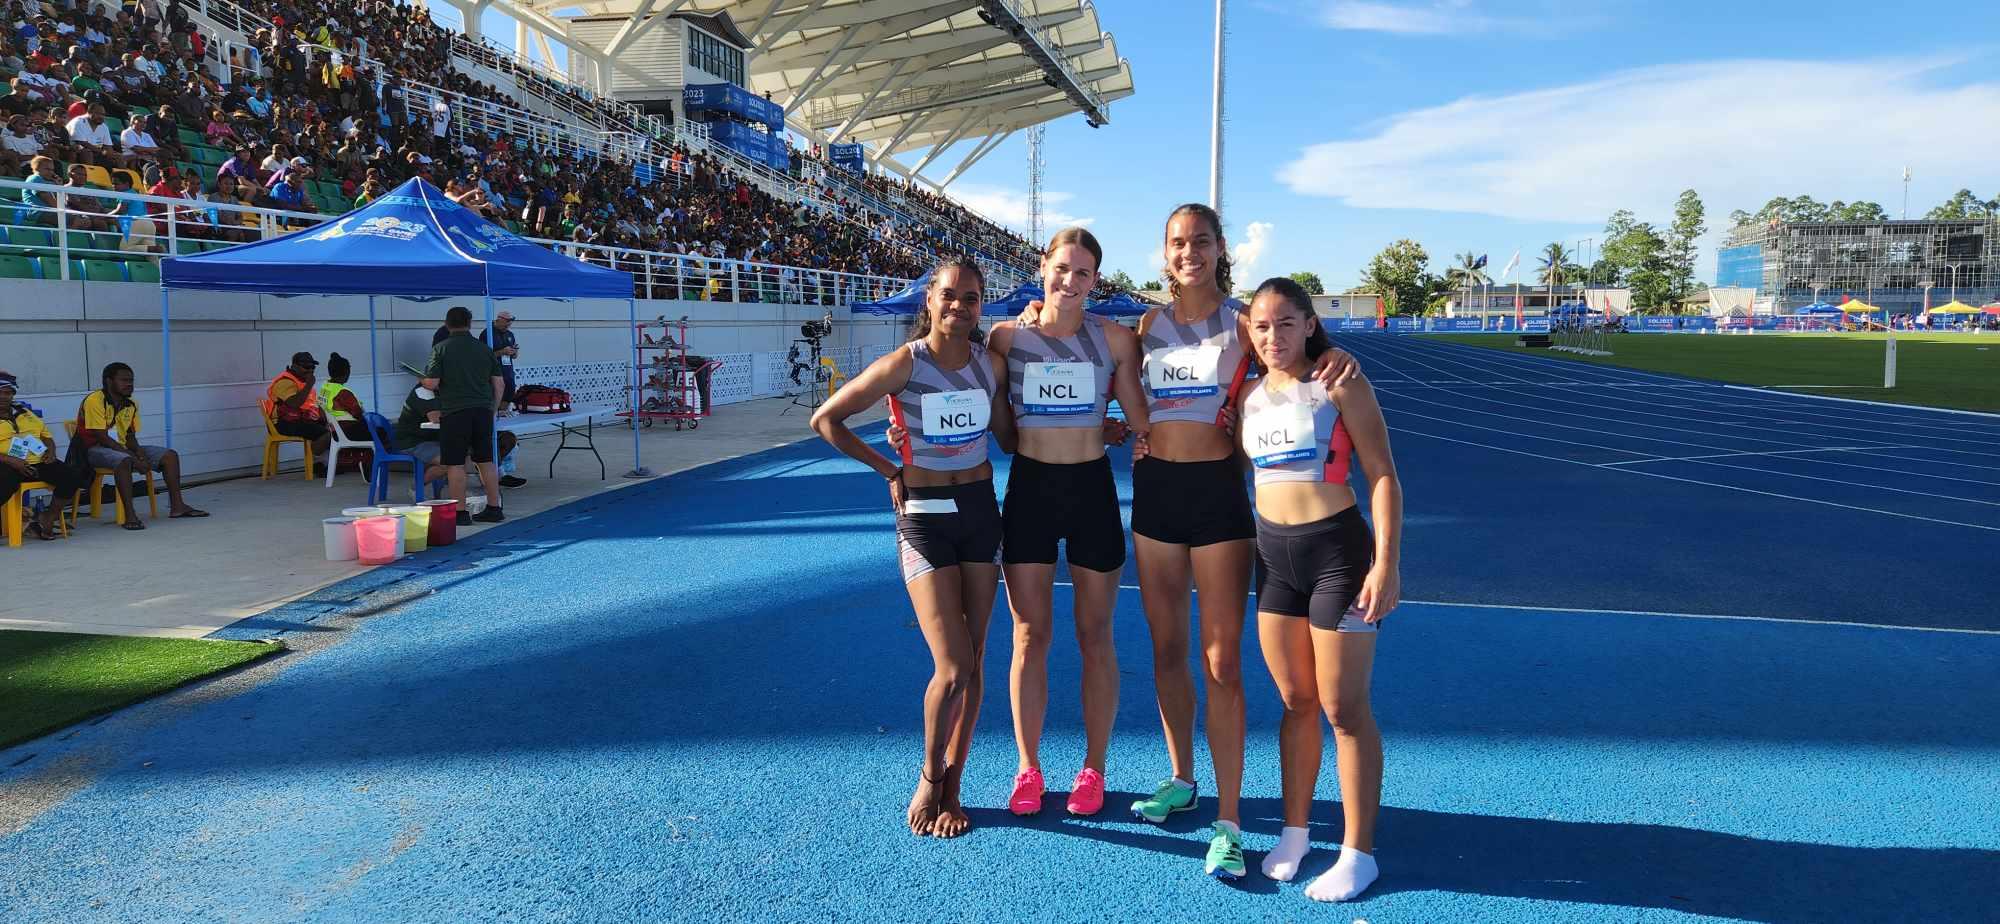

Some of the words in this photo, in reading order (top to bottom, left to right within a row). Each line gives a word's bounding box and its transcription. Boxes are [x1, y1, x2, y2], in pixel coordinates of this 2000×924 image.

[1163, 366, 1199, 382] NCL
[1040, 384, 1078, 399] NCL
[940, 412, 977, 429] NCL
[1258, 428, 1295, 448] NCL
